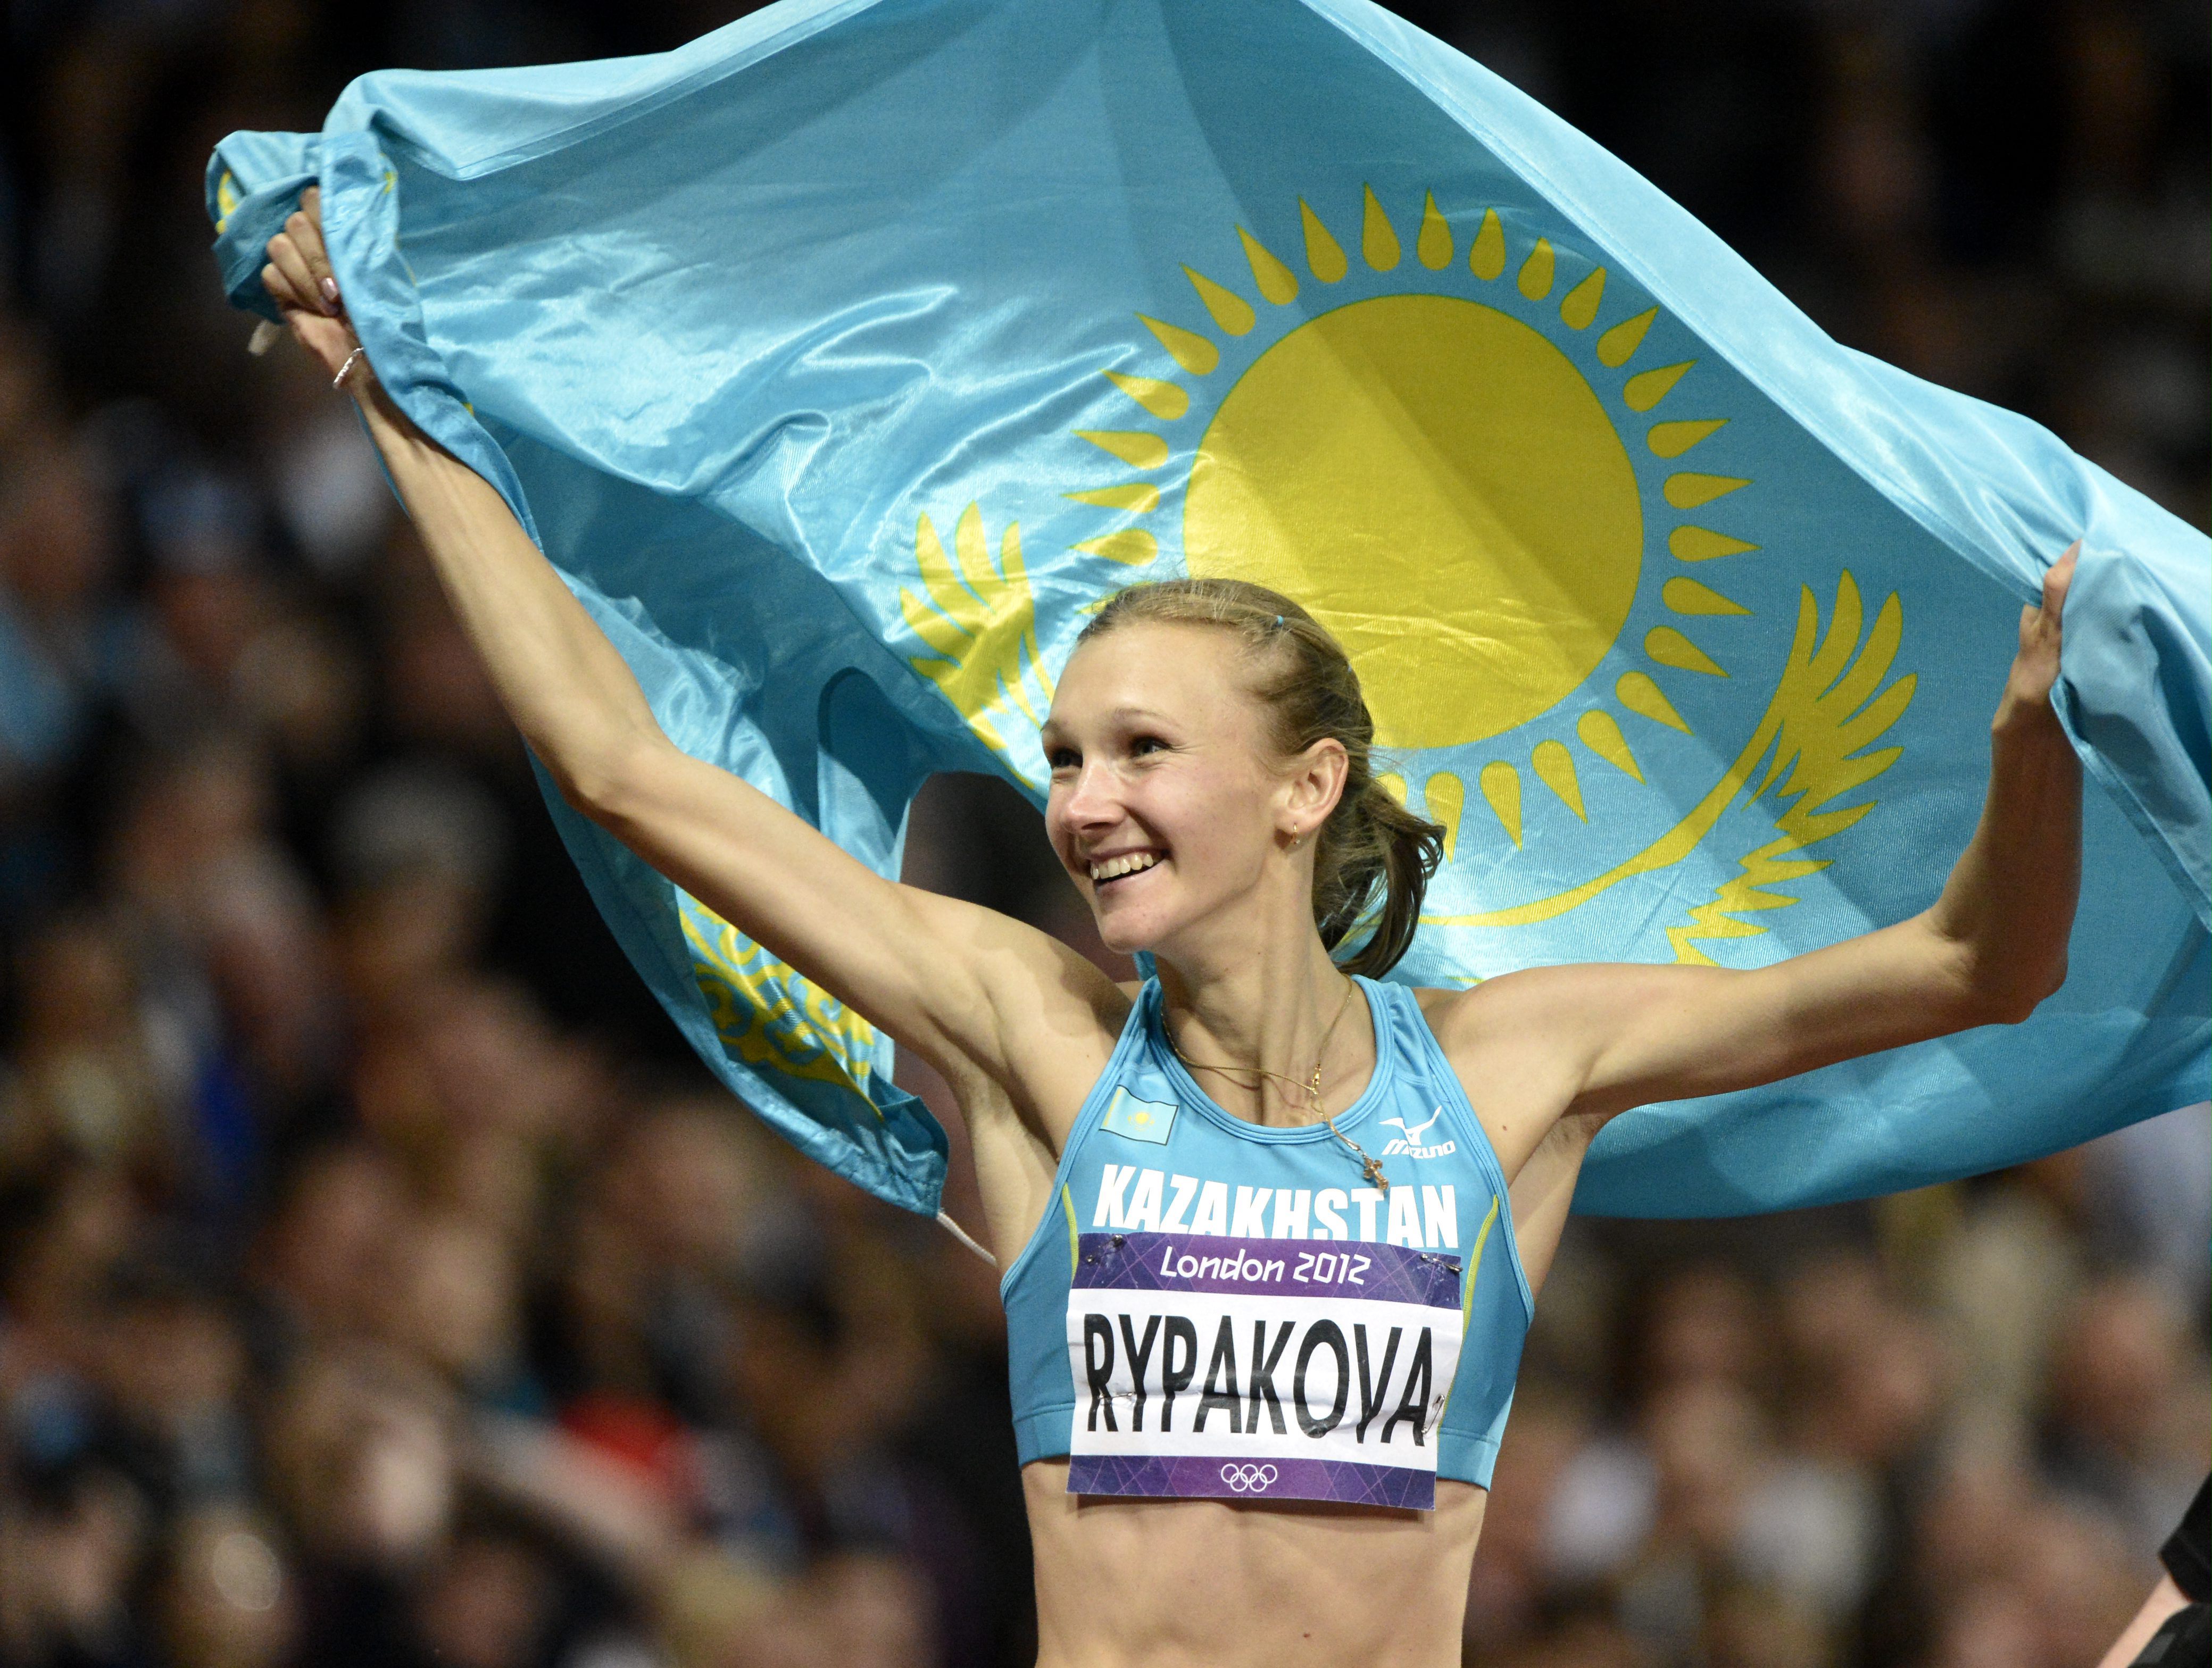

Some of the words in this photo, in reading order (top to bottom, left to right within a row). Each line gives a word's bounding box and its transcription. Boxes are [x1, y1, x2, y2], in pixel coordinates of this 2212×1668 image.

[1092, 1164, 1459, 1248] KAZAKHSTAN
[1160, 1246, 1285, 1282] London
[1292, 1252, 1371, 1285] 2012
[1084, 1313, 1432, 1447] RYPAKOVA
